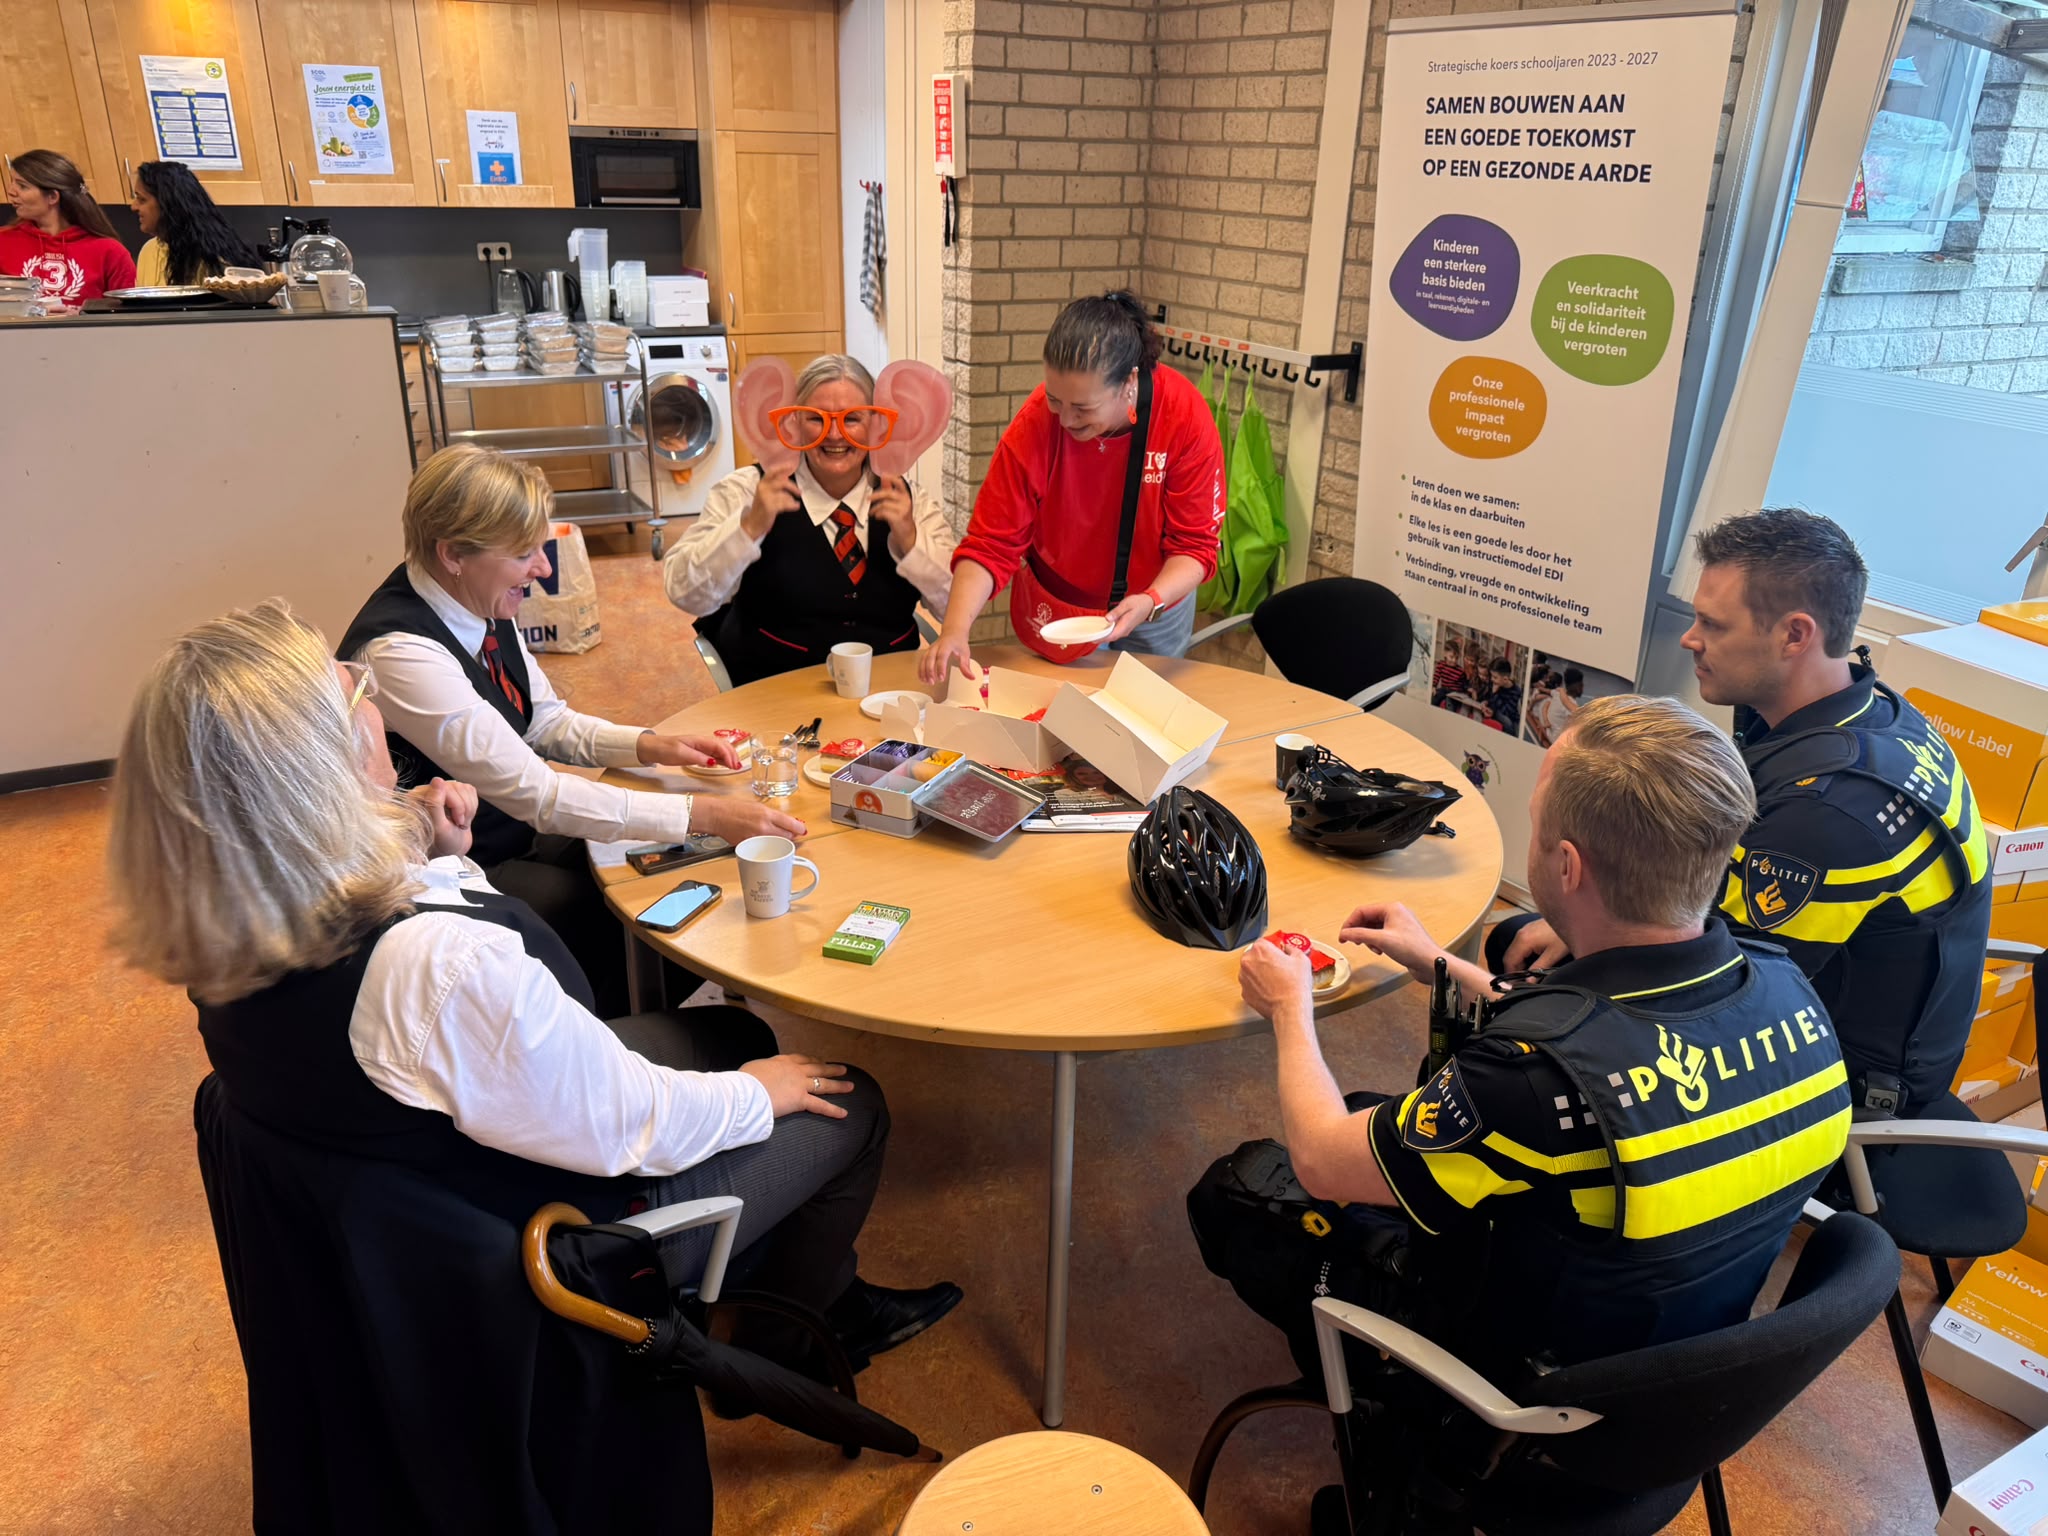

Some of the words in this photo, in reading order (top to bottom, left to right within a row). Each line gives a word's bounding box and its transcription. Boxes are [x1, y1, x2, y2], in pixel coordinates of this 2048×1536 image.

[1428, 57, 1488, 75] Strategische
[1490, 56, 1518, 70] koers
[1520, 55, 1584, 72] schooljaren
[1587, 53, 1616, 67] 2023
[1627, 51, 1658, 66] 2027
[313, 84, 334, 94] Jouw
[334, 83, 361, 94] energie
[362, 84, 376, 92] telt
[1426, 96, 1485, 115] SAMEN
[1490, 94, 1575, 114] BOUWEN
[1578, 93, 1625, 114] AAN
[1424, 128, 1457, 146] EEN
[1460, 128, 1521, 147] GOEDE
[1527, 128, 1636, 149] TOEKOMST
[1422, 159, 1446, 176] OP
[1450, 159, 1481, 178] EEN
[1485, 160, 1575, 181] GEZONDE
[1578, 163, 1652, 183] AARDE
[1433, 239, 1479, 255] Kinderen
[41, 260, 67, 291] 3
[1423, 259, 1443, 270] een
[1444, 258, 1487, 274] sterkere
[1422, 272, 1447, 287] basis
[1449, 275, 1485, 292] bieden
[1567, 280, 1639, 300] Veerkracht
[1556, 301, 1572, 313] en
[1574, 302, 1647, 321] solidariteit
[1550, 317, 1566, 334] bij
[1568, 319, 1585, 333] de
[1587, 321, 1647, 341] kinderen
[1563, 338, 1628, 358] vergroten
[1472, 374, 1504, 391] Onze
[1449, 388, 1525, 413] professionele
[1465, 408, 1505, 427] impact
[1455, 424, 1511, 444] vergroten
[1145, 452, 1155, 469] I
[1412, 475, 1435, 492] Leren
[1436, 480, 1462, 497] doen
[1464, 487, 1480, 500] we
[1482, 493, 1520, 511] samen:
[1410, 491, 1419, 503] in
[1420, 493, 1431, 506] de
[1433, 495, 1452, 511] klas
[1454, 504, 1467, 515] en
[1469, 504, 1526, 529] daarbuiten
[1408, 514, 1426, 530] Elke
[1427, 519, 1441, 534] les
[1442, 523, 1451, 536] is
[1452, 528, 1472, 541] een
[1474, 530, 1507, 552] goede
[1508, 538, 1524, 553] les
[1526, 542, 1551, 560] door
[1553, 551, 1573, 568] het
[1407, 530, 1441, 551] gebruik
[1442, 541, 1461, 554] van
[1462, 544, 1543, 577] instructiemodel
[1544, 566, 1564, 583] EDI
[1405, 552, 1457, 579] Verbinding,
[1459, 566, 1502, 590] vreugde
[1503, 581, 1517, 593] en
[1518, 582, 1590, 617] ontwikkeling
[1404, 567, 1431, 585] staan
[1432, 574, 1467, 597] centraal
[1468, 583, 1479, 598] in
[1481, 590, 1499, 605] ons
[1500, 597, 1571, 626] professionele
[1574, 618, 1603, 636] team
[519, 624, 558, 643] ION
[1921, 711, 1966, 740] ellow
[1968, 728, 2013, 759] Label
[2005, 839, 2044, 855] Canon
[1751, 855, 1809, 885] POLITIE
[1627, 1008, 1819, 1113] POLITIE
[1440, 1066, 1469, 1129] POLITIE
[1869, 1095, 1893, 1109] TQ
[1984, 1261, 2048, 1299] Yellow
[1988, 1479, 2035, 1511] Canon
